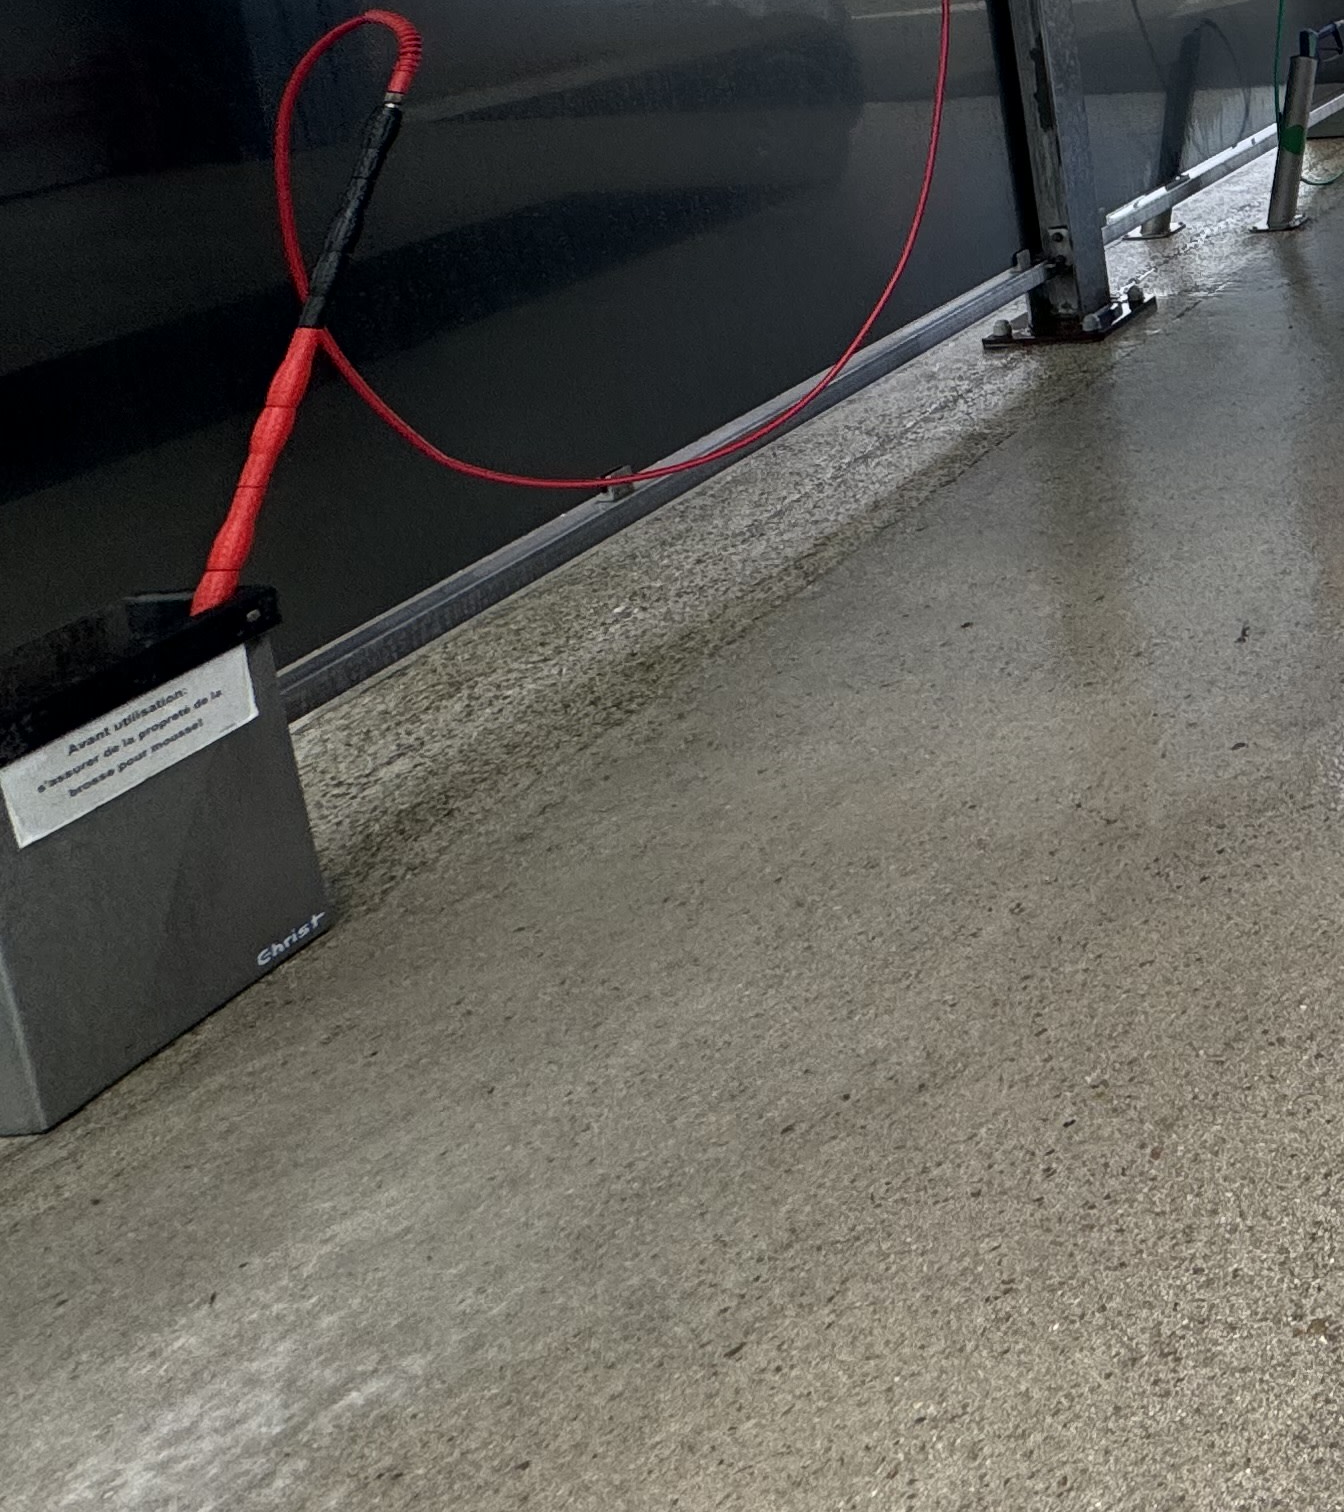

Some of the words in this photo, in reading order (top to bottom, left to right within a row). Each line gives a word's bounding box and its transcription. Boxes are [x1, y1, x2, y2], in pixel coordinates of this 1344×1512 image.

[37, 756, 100, 794] s'assurer
[103, 744, 120, 758] de
[122, 736, 136, 748] la
[138, 705, 191, 742] propreté
[193, 697, 208, 710] de
[67, 727, 111, 757] Avant
[114, 688, 188, 732] utilisation:
[68, 769, 115, 798] brosse
[118, 749, 148, 773] pour
[151, 718, 204, 752] mousse!
[257, 911, 327, 966] Christ
